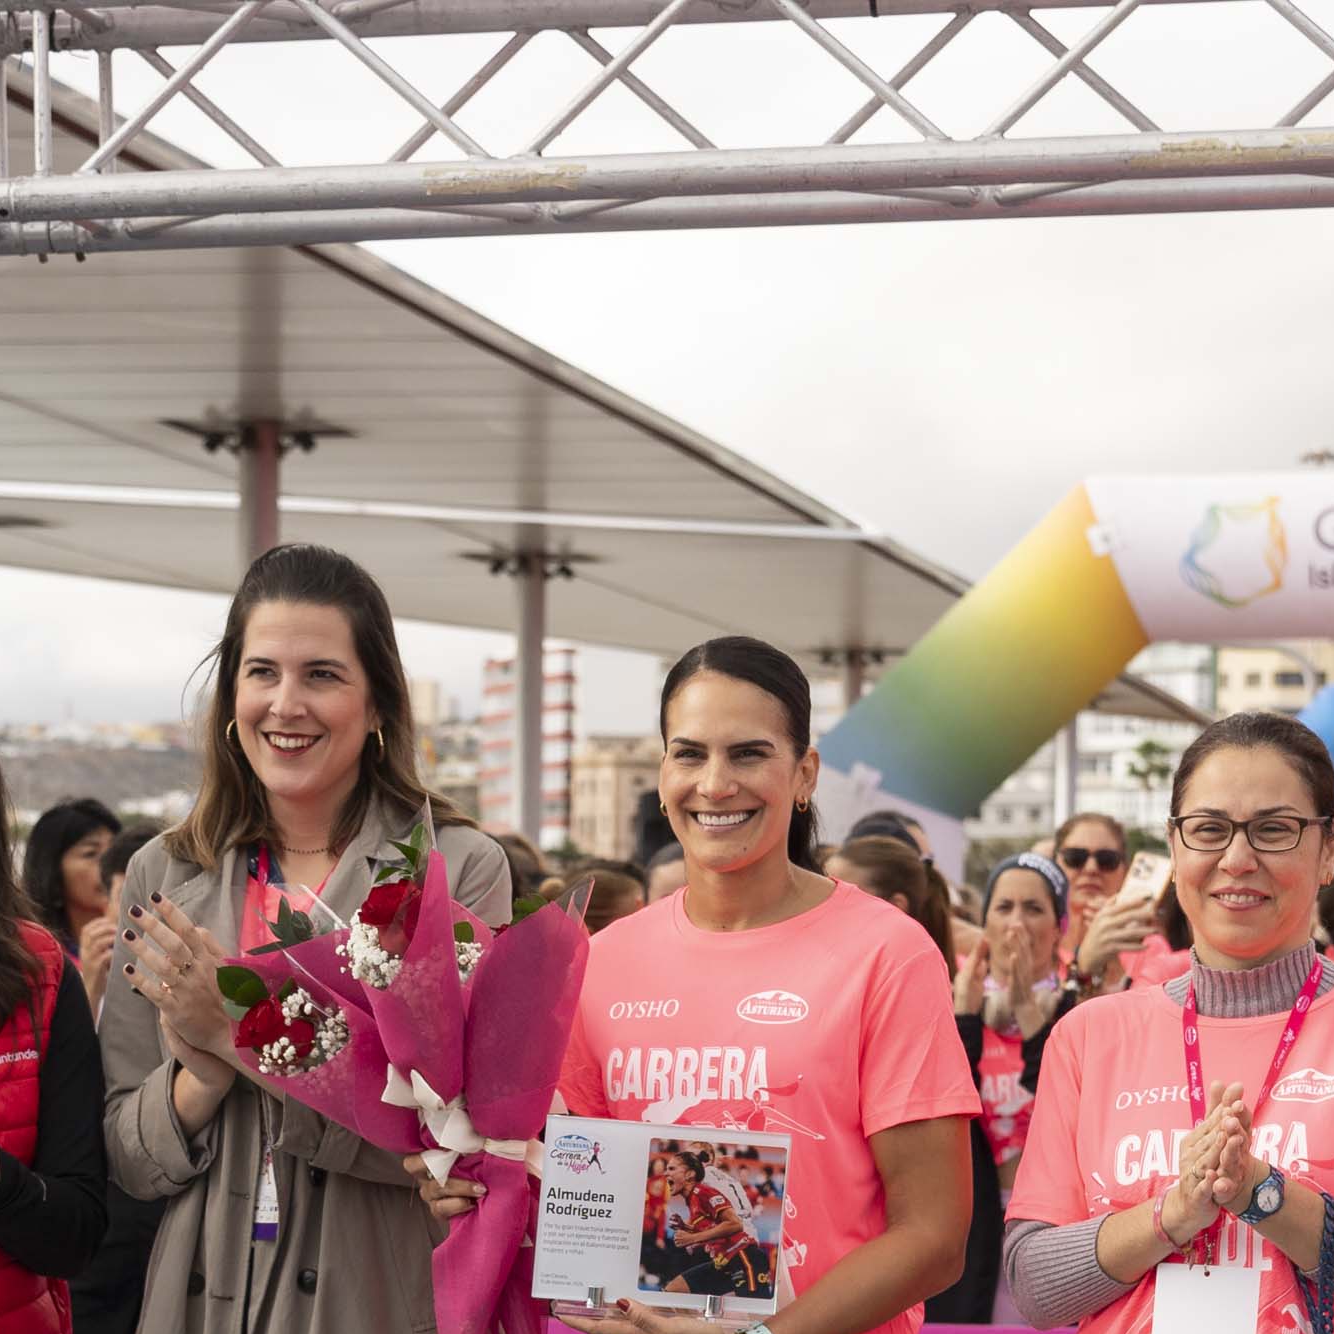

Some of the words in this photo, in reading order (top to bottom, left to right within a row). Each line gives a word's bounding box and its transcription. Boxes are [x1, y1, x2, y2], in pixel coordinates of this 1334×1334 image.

[609, 999, 680, 1020] OYSHO
[741, 1002, 802, 1018] ASTURIANA
[607, 1046, 770, 1102] CARRERA
[550, 1149, 581, 1160] Carrera
[547, 1186, 615, 1203] Almudena
[546, 1202, 612, 1220] Rodríguez
